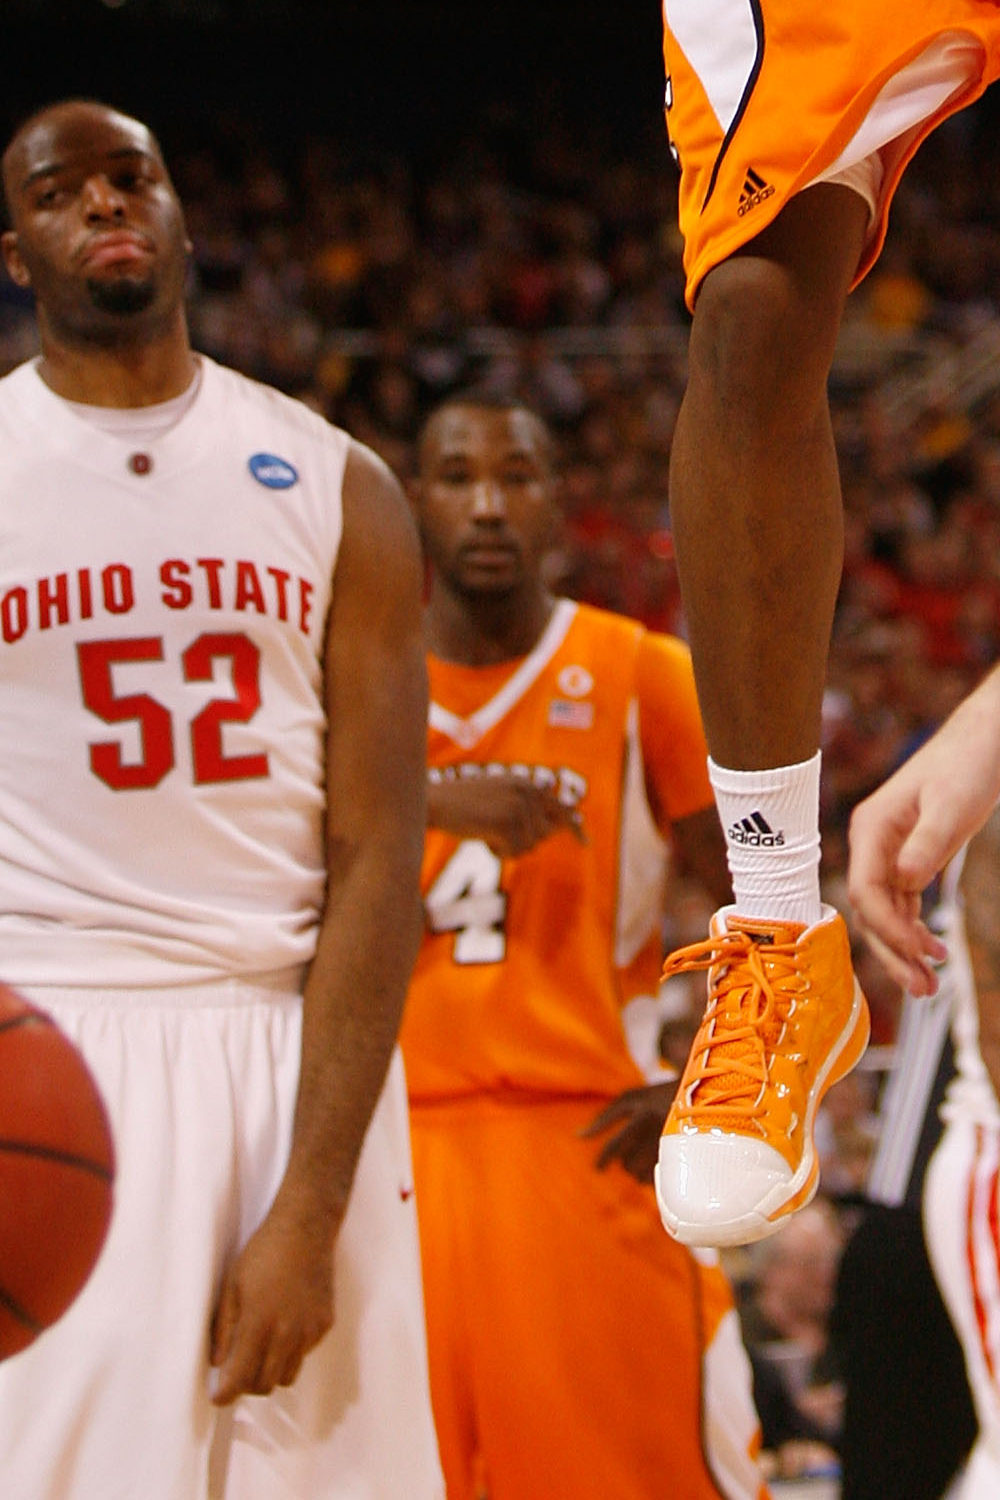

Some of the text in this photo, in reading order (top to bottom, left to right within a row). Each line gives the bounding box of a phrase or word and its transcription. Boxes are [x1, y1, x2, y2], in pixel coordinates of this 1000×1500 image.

[737, 184, 776, 218] adidas
[0, 557, 314, 644] OHIO STATE
[76, 631, 271, 792] 52
[728, 828, 786, 847] adidas
[426, 838, 506, 965] 4
